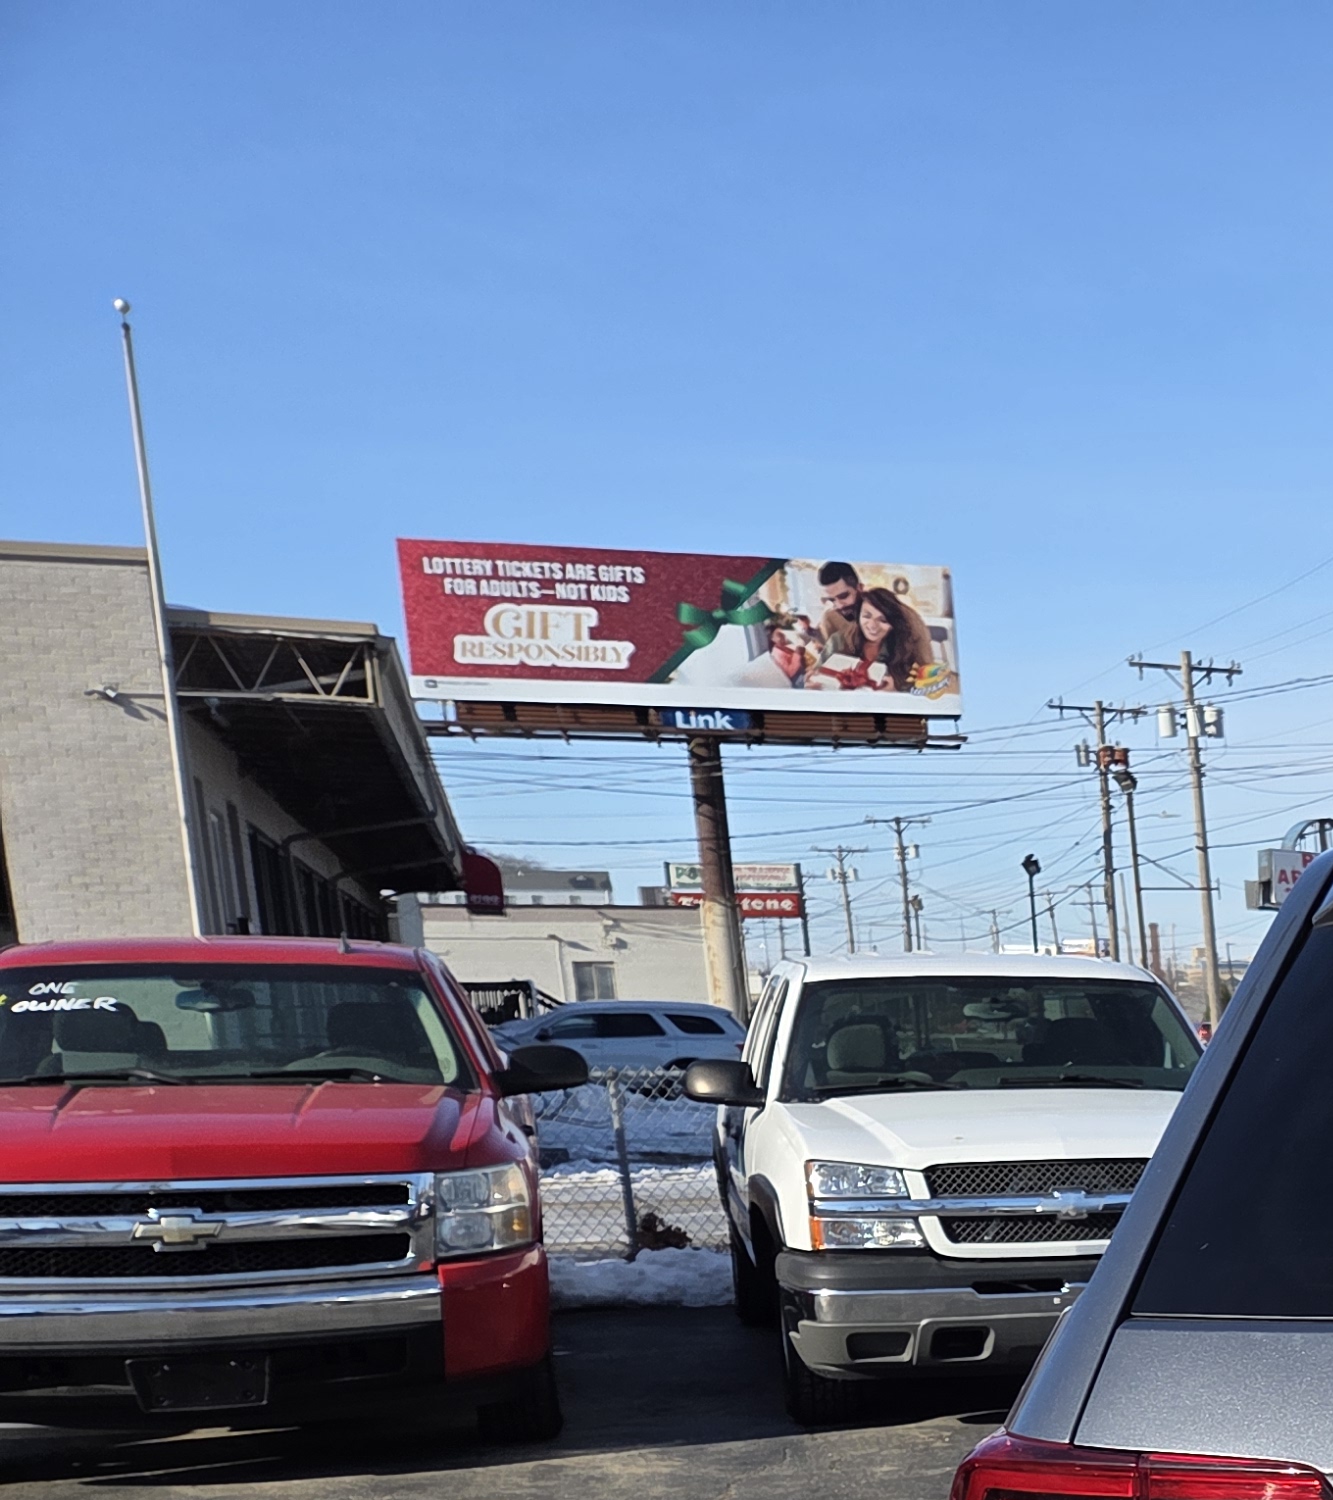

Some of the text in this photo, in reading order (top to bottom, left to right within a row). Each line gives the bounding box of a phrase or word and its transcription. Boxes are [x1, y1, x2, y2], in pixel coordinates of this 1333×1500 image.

[422, 557, 646, 584] LOTTERY TICKETS ARE GIFTS
[443, 578, 477, 595] FOR
[591, 585, 631, 602] KIDS
[491, 608, 592, 641] GIFT
[460, 640, 628, 664] RESPONSIBLY
[674, 710, 735, 730] Link
[28, 981, 79, 995] ONE
[10, 996, 118, 1013] OWNER
